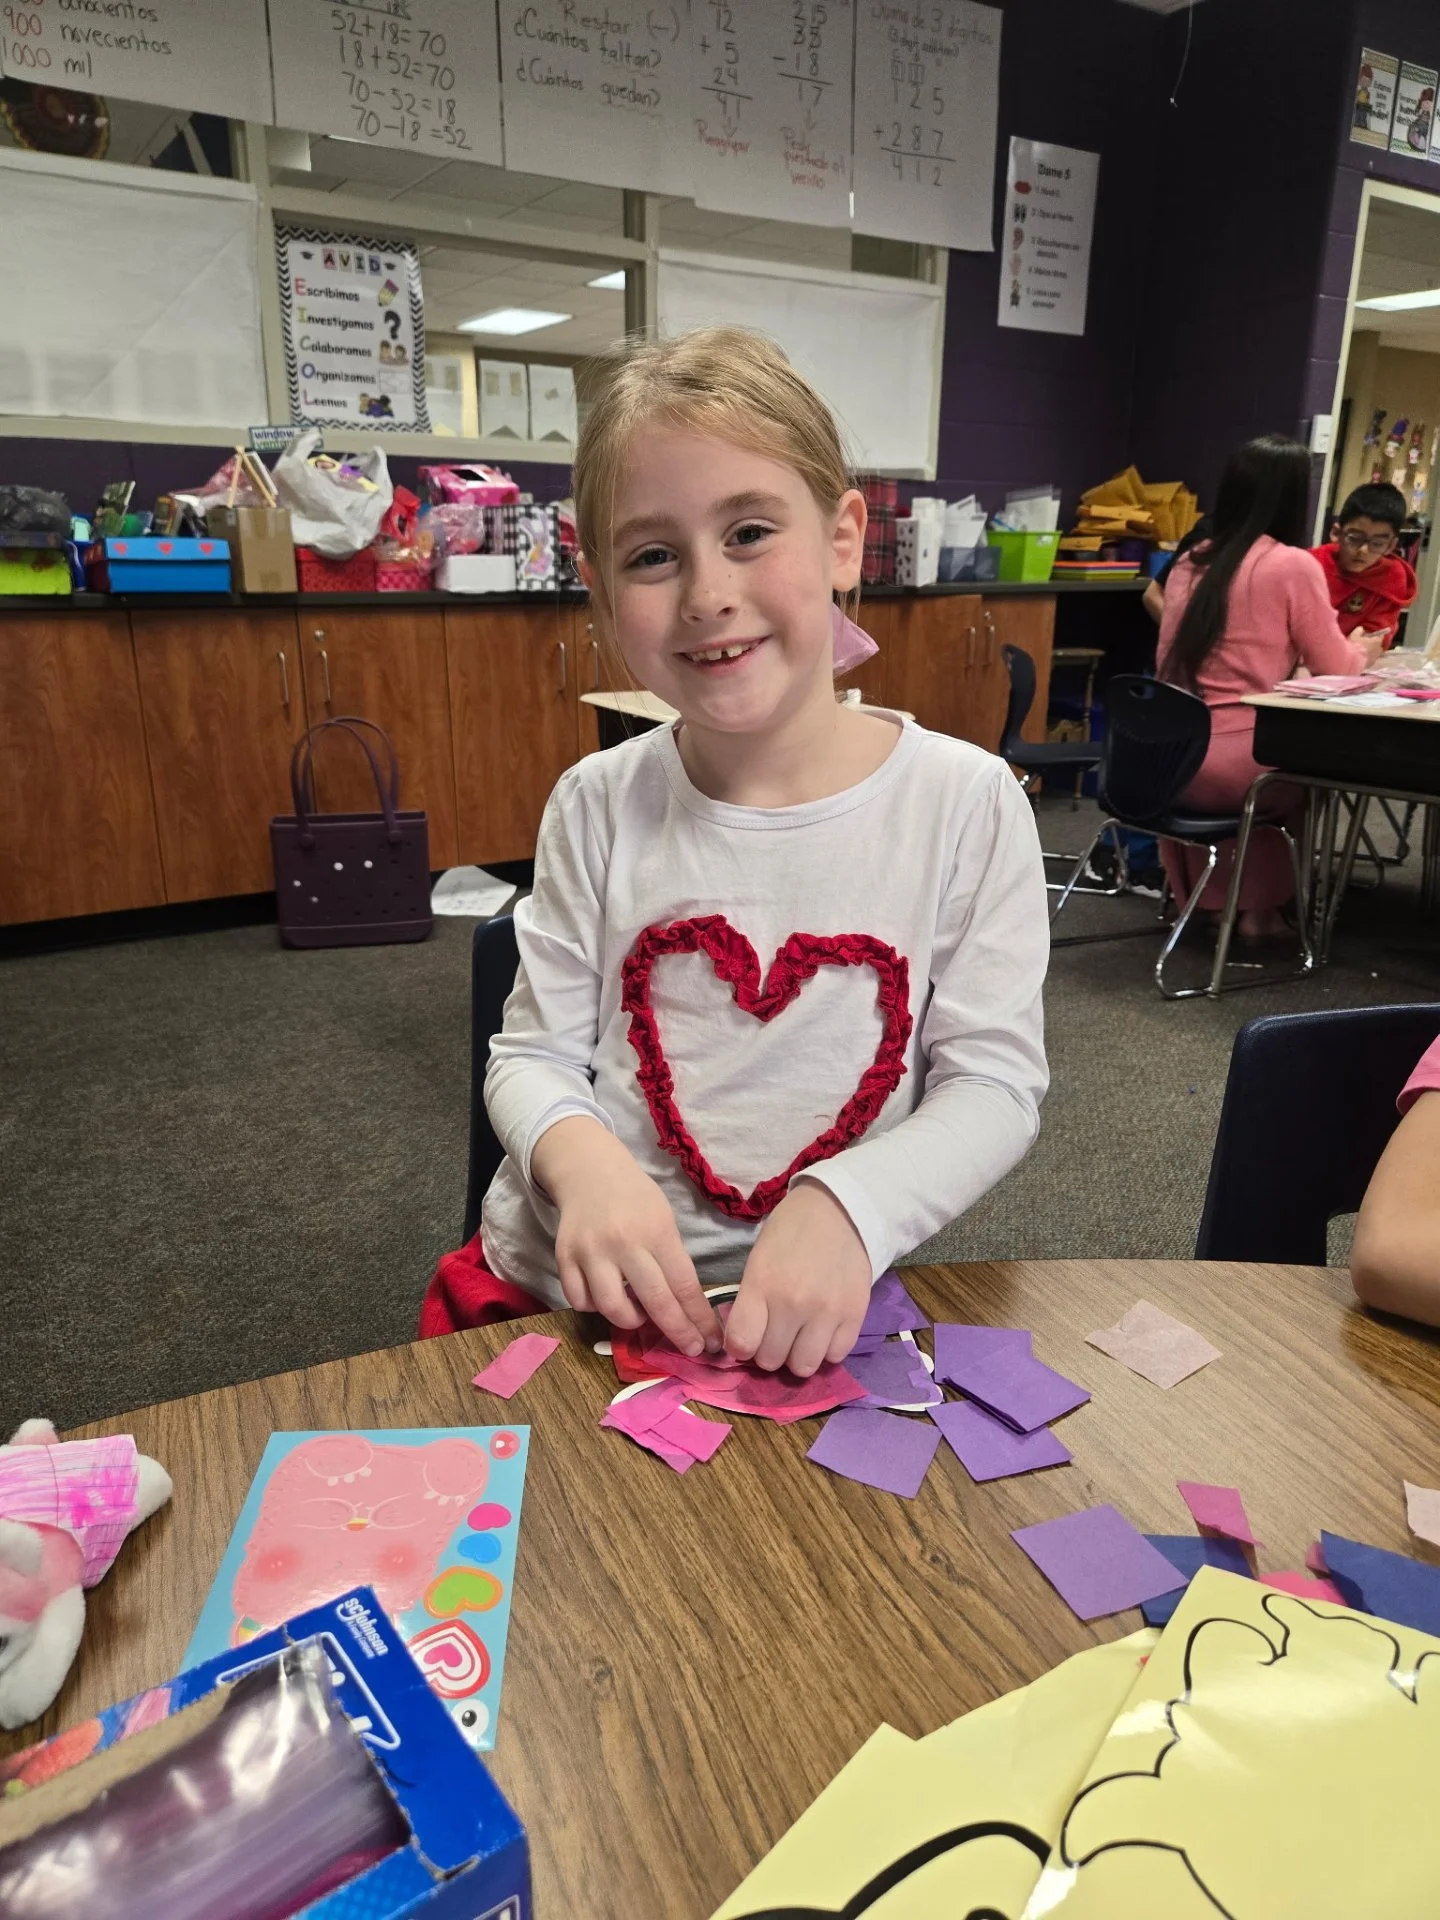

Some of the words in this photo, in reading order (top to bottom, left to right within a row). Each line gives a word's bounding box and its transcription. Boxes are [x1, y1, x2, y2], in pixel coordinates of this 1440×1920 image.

[3, 6, 42, 36] 900
[60, 23, 173, 55] novecientos
[716, 8, 736, 34] 12
[931, 8, 943, 32] 3
[2, 37, 51, 68] 1000
[63, 52, 93, 79] mil
[724, 42, 740, 65] 5
[713, 66, 739, 86] 24
[323, 251, 381, 273] AVID
[294, 277, 360, 302] Escribimos
[297, 307, 375, 331] Investigamos
[300, 335, 372, 357] Colaboramos
[302, 362, 376, 384] Organizamos
[303, 389, 348, 409] Leemos
[254, 430, 294, 440] window
